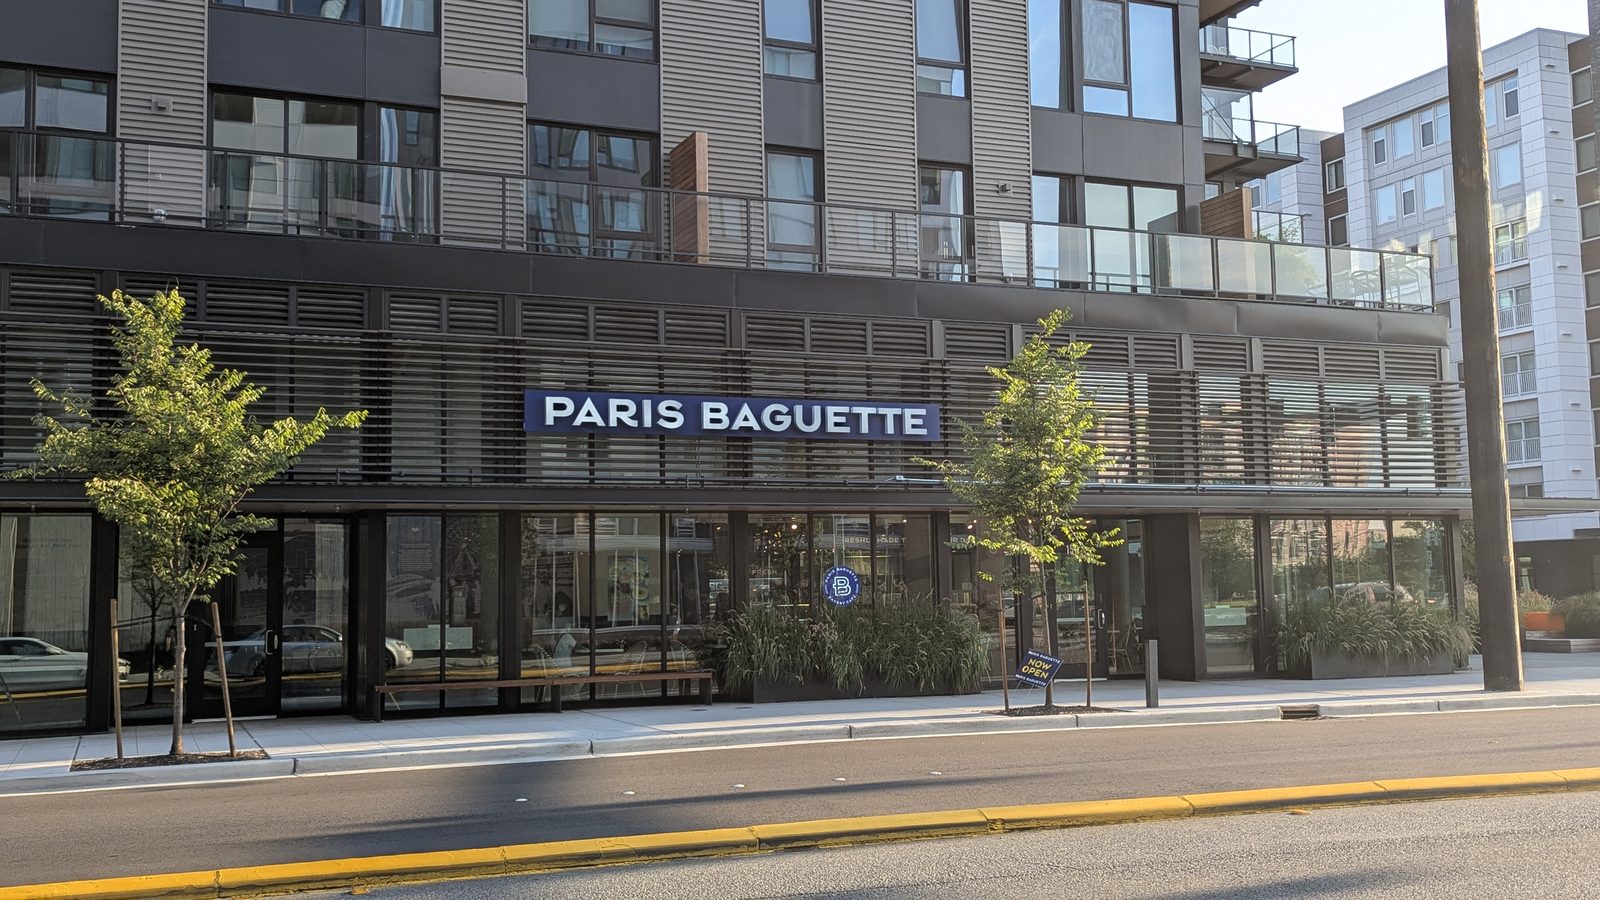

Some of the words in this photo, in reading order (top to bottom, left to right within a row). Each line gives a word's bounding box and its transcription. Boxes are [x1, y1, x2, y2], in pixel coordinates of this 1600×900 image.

[544, 396, 685, 429] PARIS
[701, 401, 928, 436] BAGUETTE
[1028, 658, 1052, 670] NOW
[1022, 665, 1049, 679] OPEN
